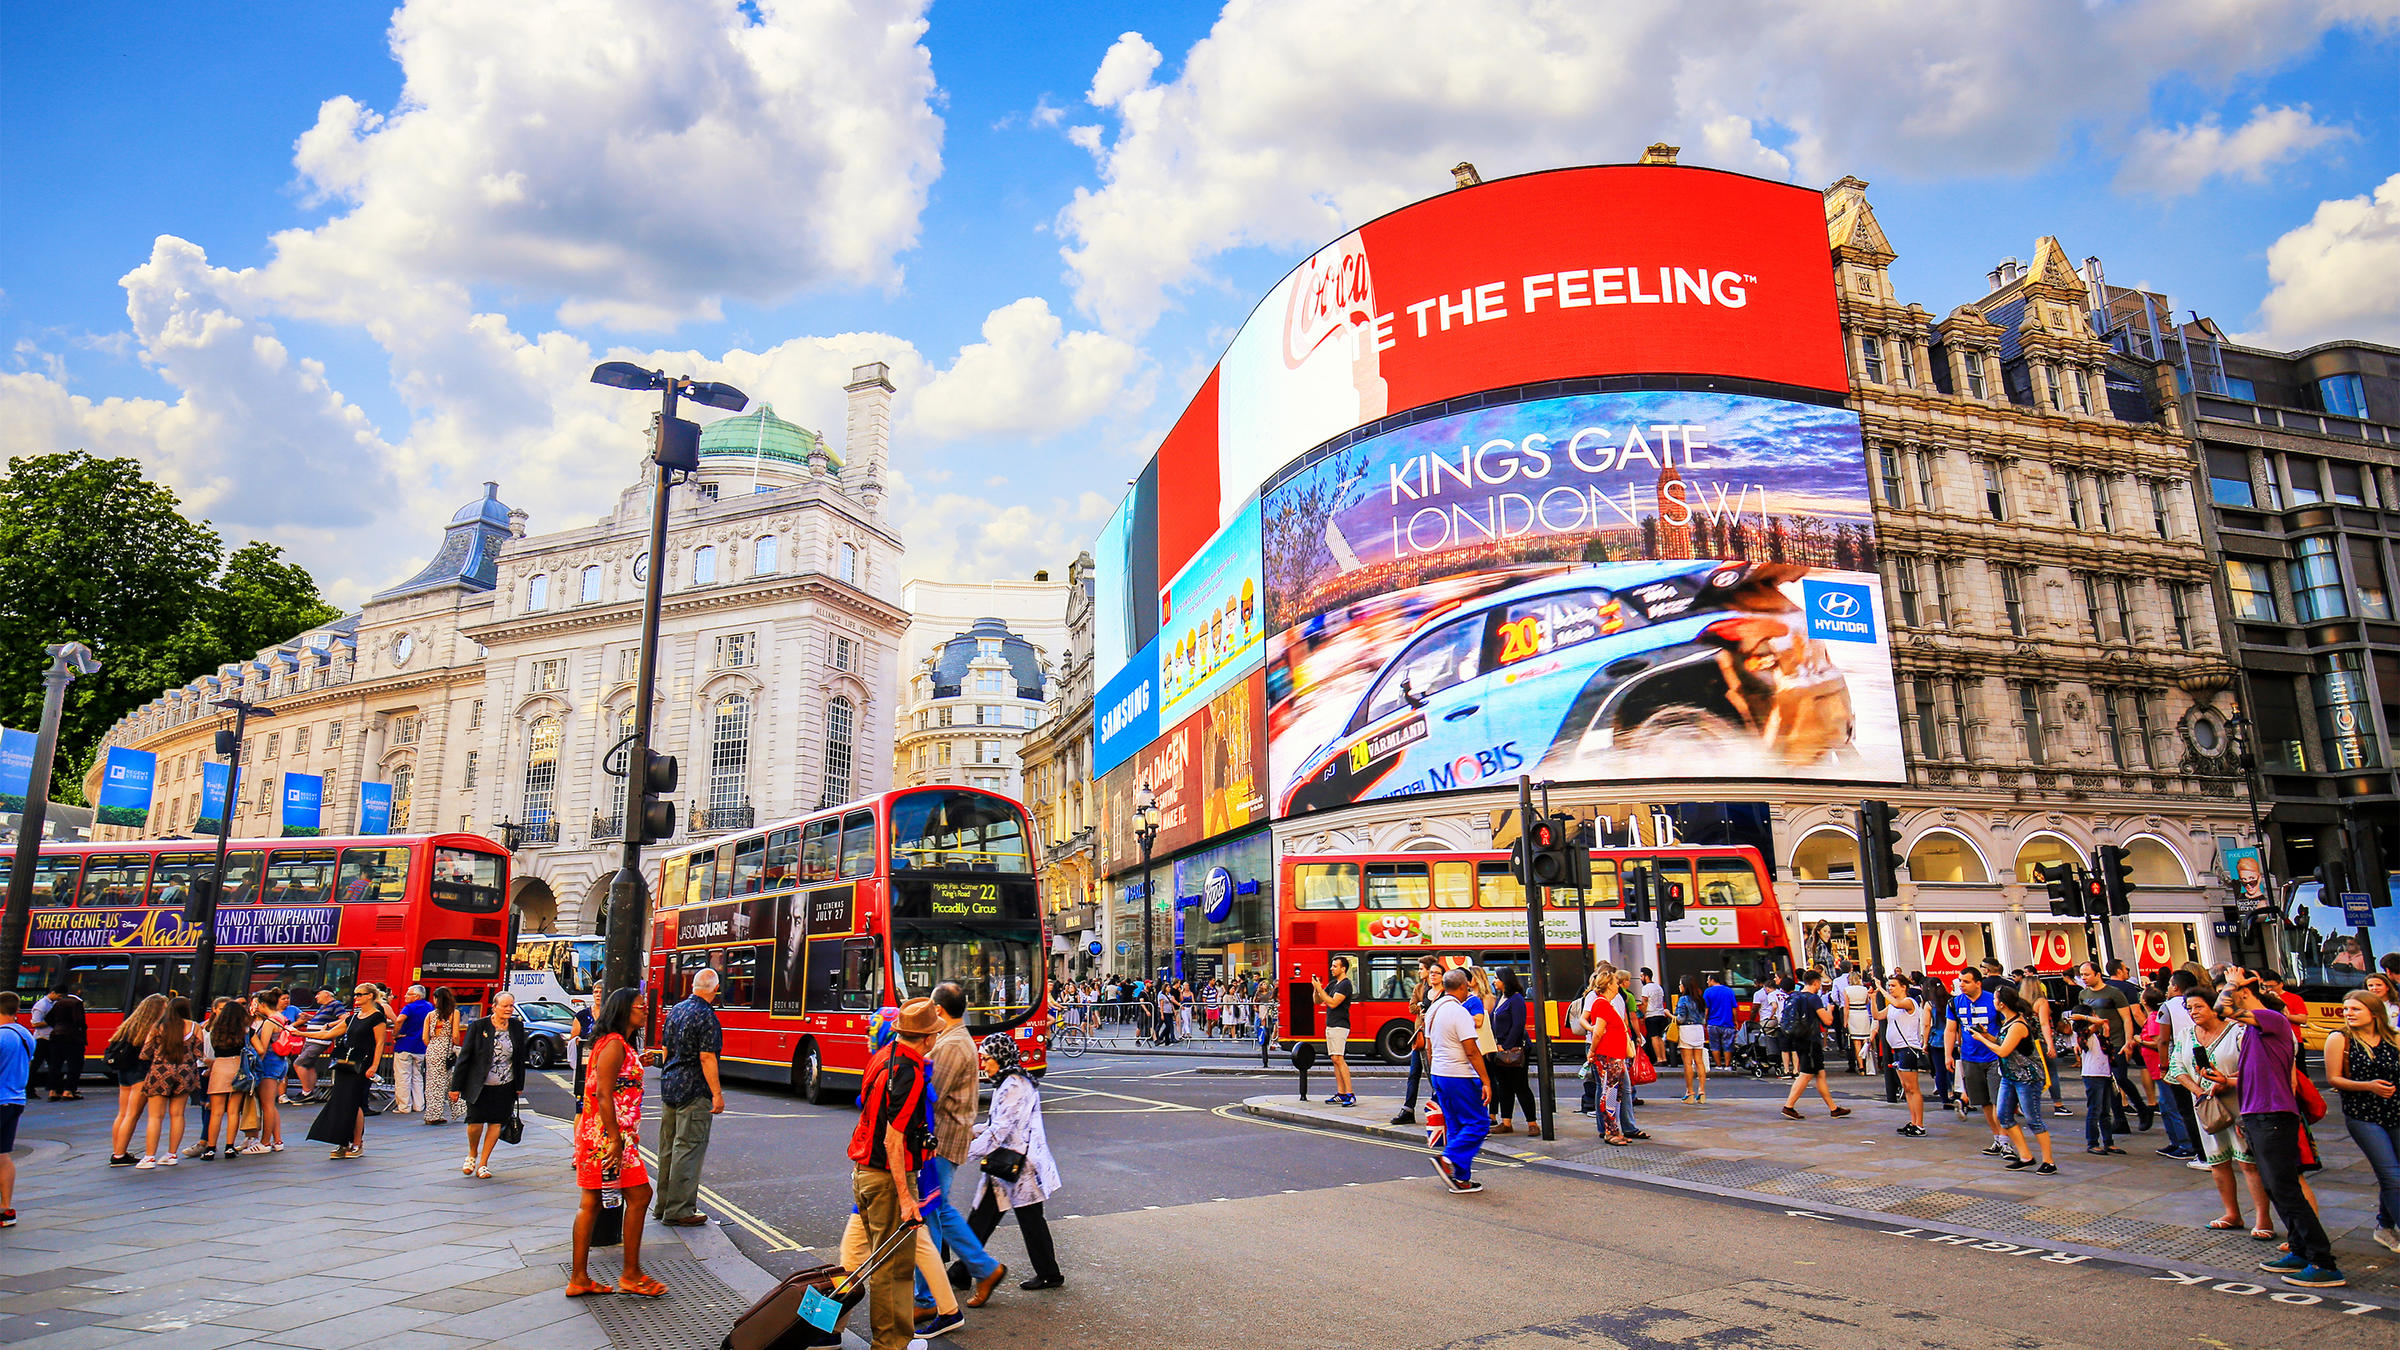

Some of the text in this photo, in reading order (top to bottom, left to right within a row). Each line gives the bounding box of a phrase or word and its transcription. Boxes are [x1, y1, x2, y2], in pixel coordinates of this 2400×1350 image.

[1406, 281, 1508, 338] THE
[1389, 423, 1712, 505] KINGS GATE
[1391, 480, 1769, 559] LONDON SW1
[1497, 616, 1540, 664] 20
[1814, 618, 1869, 634] HYUNDAI
[1101, 679, 1150, 745] SAMSUNG
[1153, 726, 1189, 791] DAGEN
[1351, 740, 1370, 773] 20
[1428, 740, 1524, 792] MOBIS
[474, 891, 484, 902] 14
[933, 883, 948, 891] Hyde
[980, 884, 996, 900] 22
[1203, 874, 1227, 915] Boots
[253, 908, 334, 927] TRIUMPHANTLY
[815, 900, 845, 911] IN CINEMAS
[815, 909, 844, 922] JULY 27
[932, 902, 997, 916] Piccadilly Circus
[33, 929, 62, 947] WISH
[215, 926, 230, 945] IN
[234, 926, 260, 944] THE
[264, 924, 299, 944] WEST
[1440, 919, 1482, 928] Fresher.
[1442, 930, 1465, 938] With
[1466, 930, 1511, 940] Hotpoint
[1921, 929, 1967, 966] 70
[2031, 929, 2072, 966] 70
[2134, 930, 2171, 964] 70
[513, 973, 546, 987] MAJESTIC
[774, 1001, 800, 1009] BOOK NOW
[1880, 1228, 2382, 1316] LOOK RIGHT
